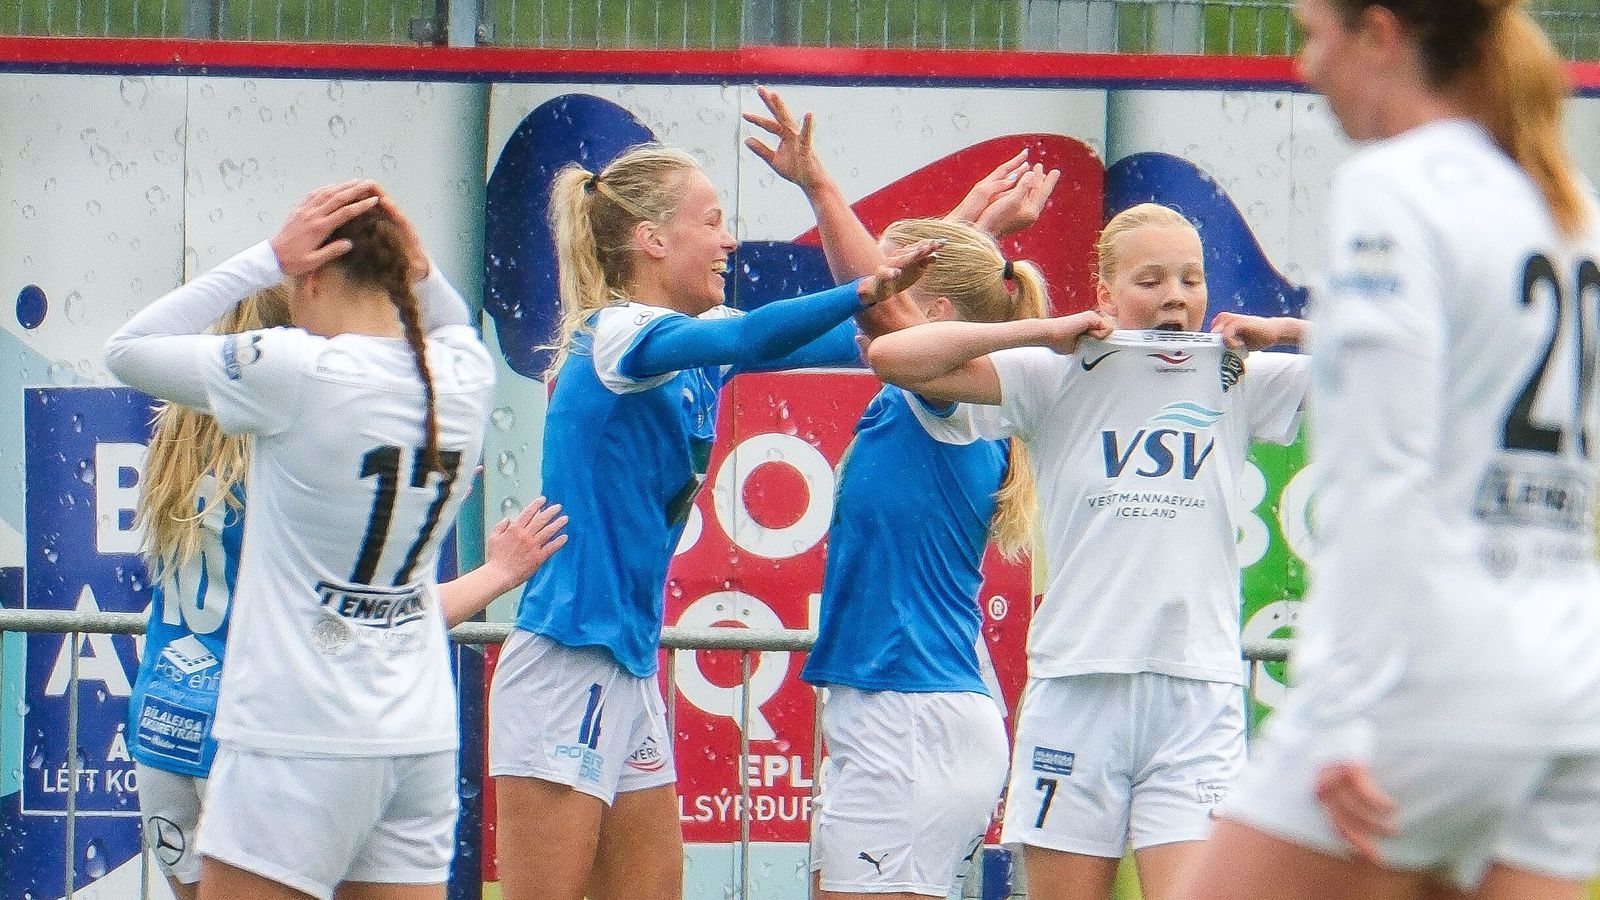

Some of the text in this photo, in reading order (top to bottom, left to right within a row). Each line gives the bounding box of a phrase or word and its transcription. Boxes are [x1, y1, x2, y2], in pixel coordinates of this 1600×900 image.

[1100, 428, 1215, 480] VSV
[358, 445, 463, 586] 17
[1115, 507, 1177, 519] ICELAND
[43, 762, 99, 793] LÉTT
[1034, 777, 1057, 829] 7
